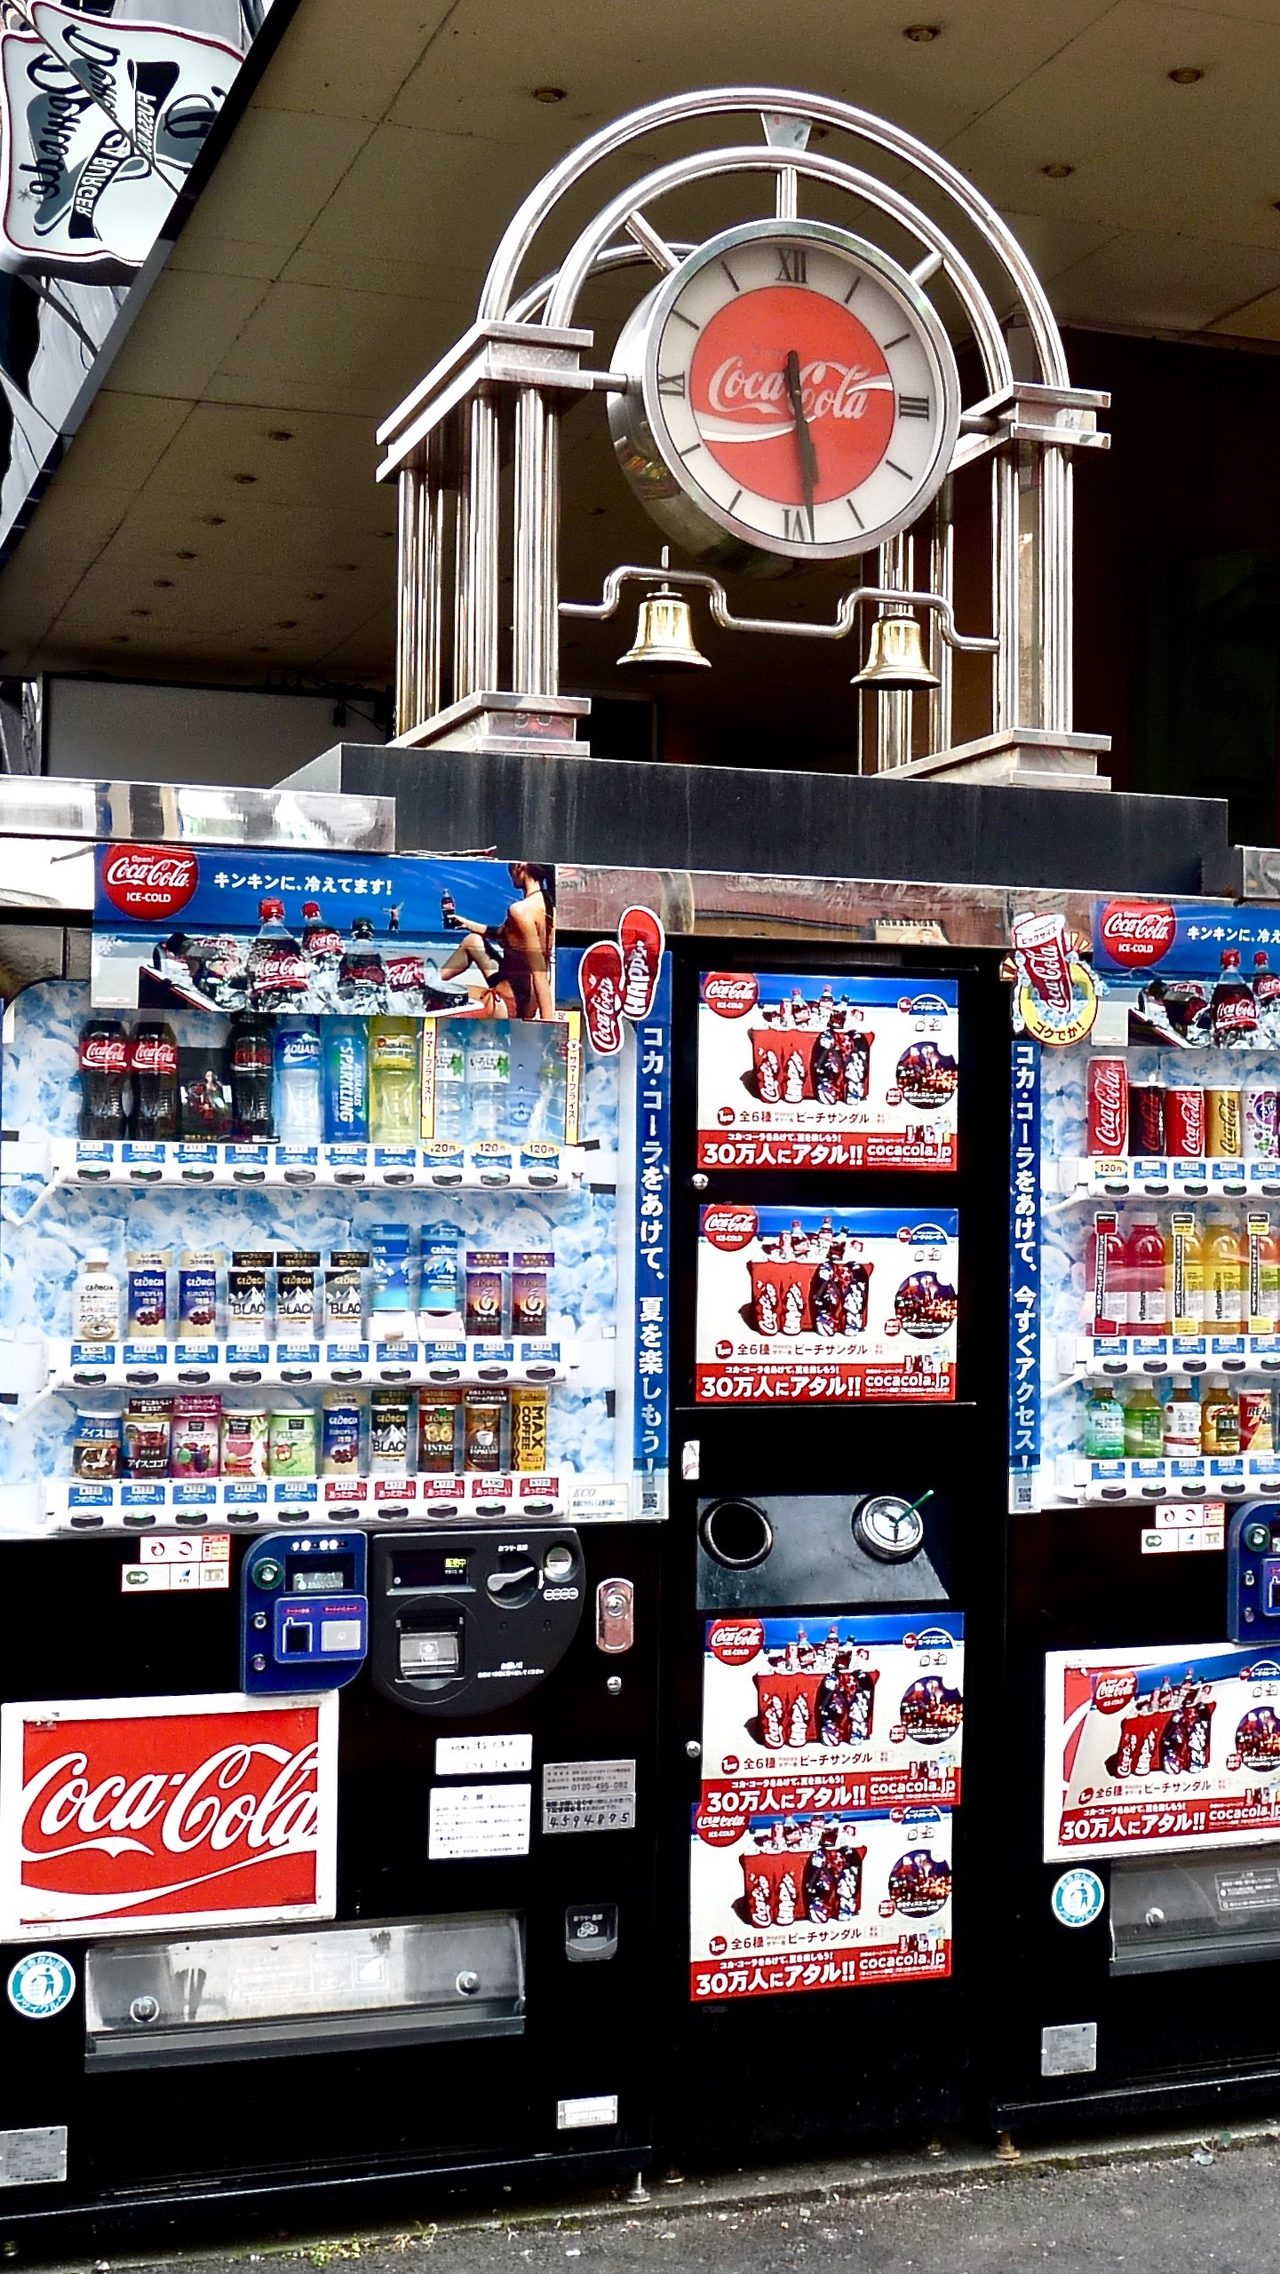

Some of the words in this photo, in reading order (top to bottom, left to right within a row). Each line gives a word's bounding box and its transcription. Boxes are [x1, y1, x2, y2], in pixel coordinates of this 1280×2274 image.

[708, 354, 871, 420] CocaCola
[106, 856, 195, 888] Coca-Cola
[126, 891, 172, 903] ICE-COLD
[1103, 912, 1173, 940] Coca-Cola
[1118, 943, 1154, 954] ICE-COLD
[796, 1111, 870, 1124] ビーチサンダル
[702, 1143, 864, 1166] 30万人にアタル!!
[866, 1143, 953, 1159] cocacola.jp
[794, 1343, 868, 1356] ビーチサンダル
[700, 1376, 862, 1398] 30万人にアタル!!
[865, 1375, 951, 1391] cocacola.jp
[521, 1406, 531, 1450] COFFEE
[531, 1406, 544, 1450] MAX
[799, 1752, 873, 1767] ビーチサンダル
[870, 1777, 956, 1795] cocacola.jp
[1143, 1779, 1212, 1795] ビーチサンダル
[21, 1741, 319, 1862] Coca-Cola
[706, 1786, 866, 1813] 30万人にアタル!!
[1061, 1812, 1206, 1841] 30万人にアタル!!
[787, 1928, 862, 1945] ビーチサンダル
[859, 1950, 946, 1970] cocacola.jp
[695, 1960, 856, 1996] 30万人にアタル!!
